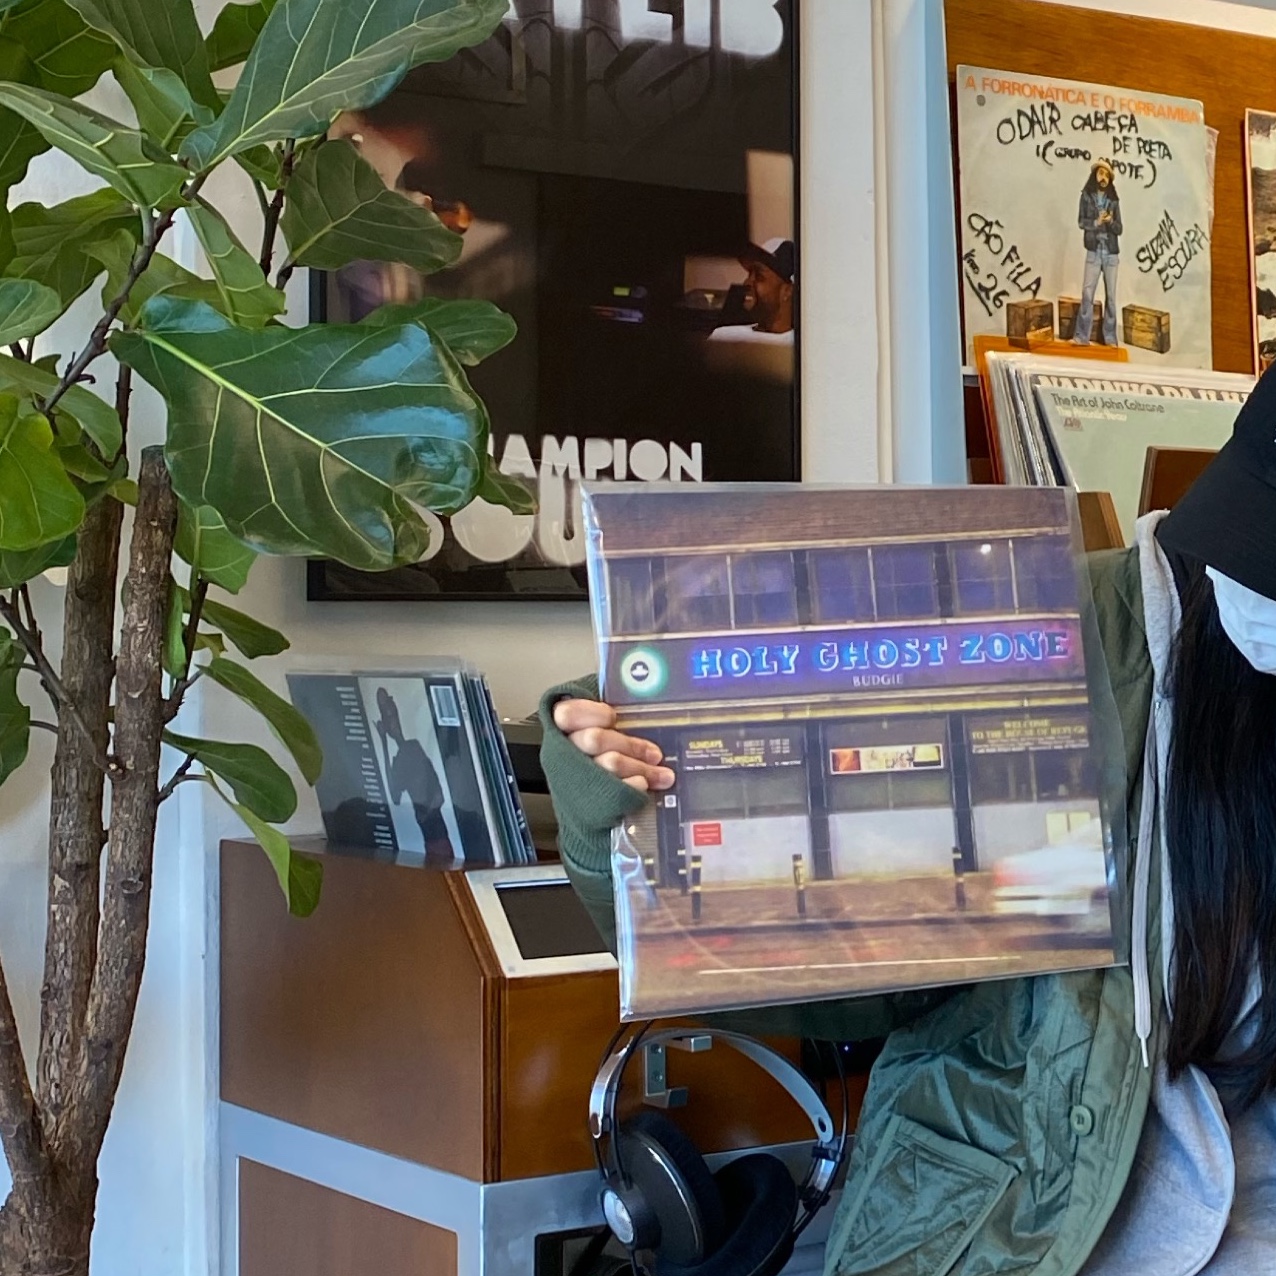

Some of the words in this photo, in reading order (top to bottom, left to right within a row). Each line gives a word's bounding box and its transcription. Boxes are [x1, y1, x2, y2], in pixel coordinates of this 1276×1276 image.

[965, 75, 976, 91] A
[1091, 93, 1099, 108] E
[1104, 95, 1115, 109] O
[996, 101, 1062, 144] ODAIR
[1113, 136, 1131, 154] DE
[1137, 137, 1172, 161] POETA
[1001, 245, 1041, 299] FILA
[1051, 393, 1071, 406] The
[1071, 395, 1089, 408] Art
[1090, 395, 1099, 409] of
[1100, 397, 1124, 411] John
[1124, 400, 1165, 414] Coltrane
[487, 433, 703, 482] AMPION
[692, 643, 800, 679] HOLY
[815, 635, 948, 673] GHOST
[959, 630, 1070, 664] ZONE
[852, 673, 904, 688] BUDGIE
